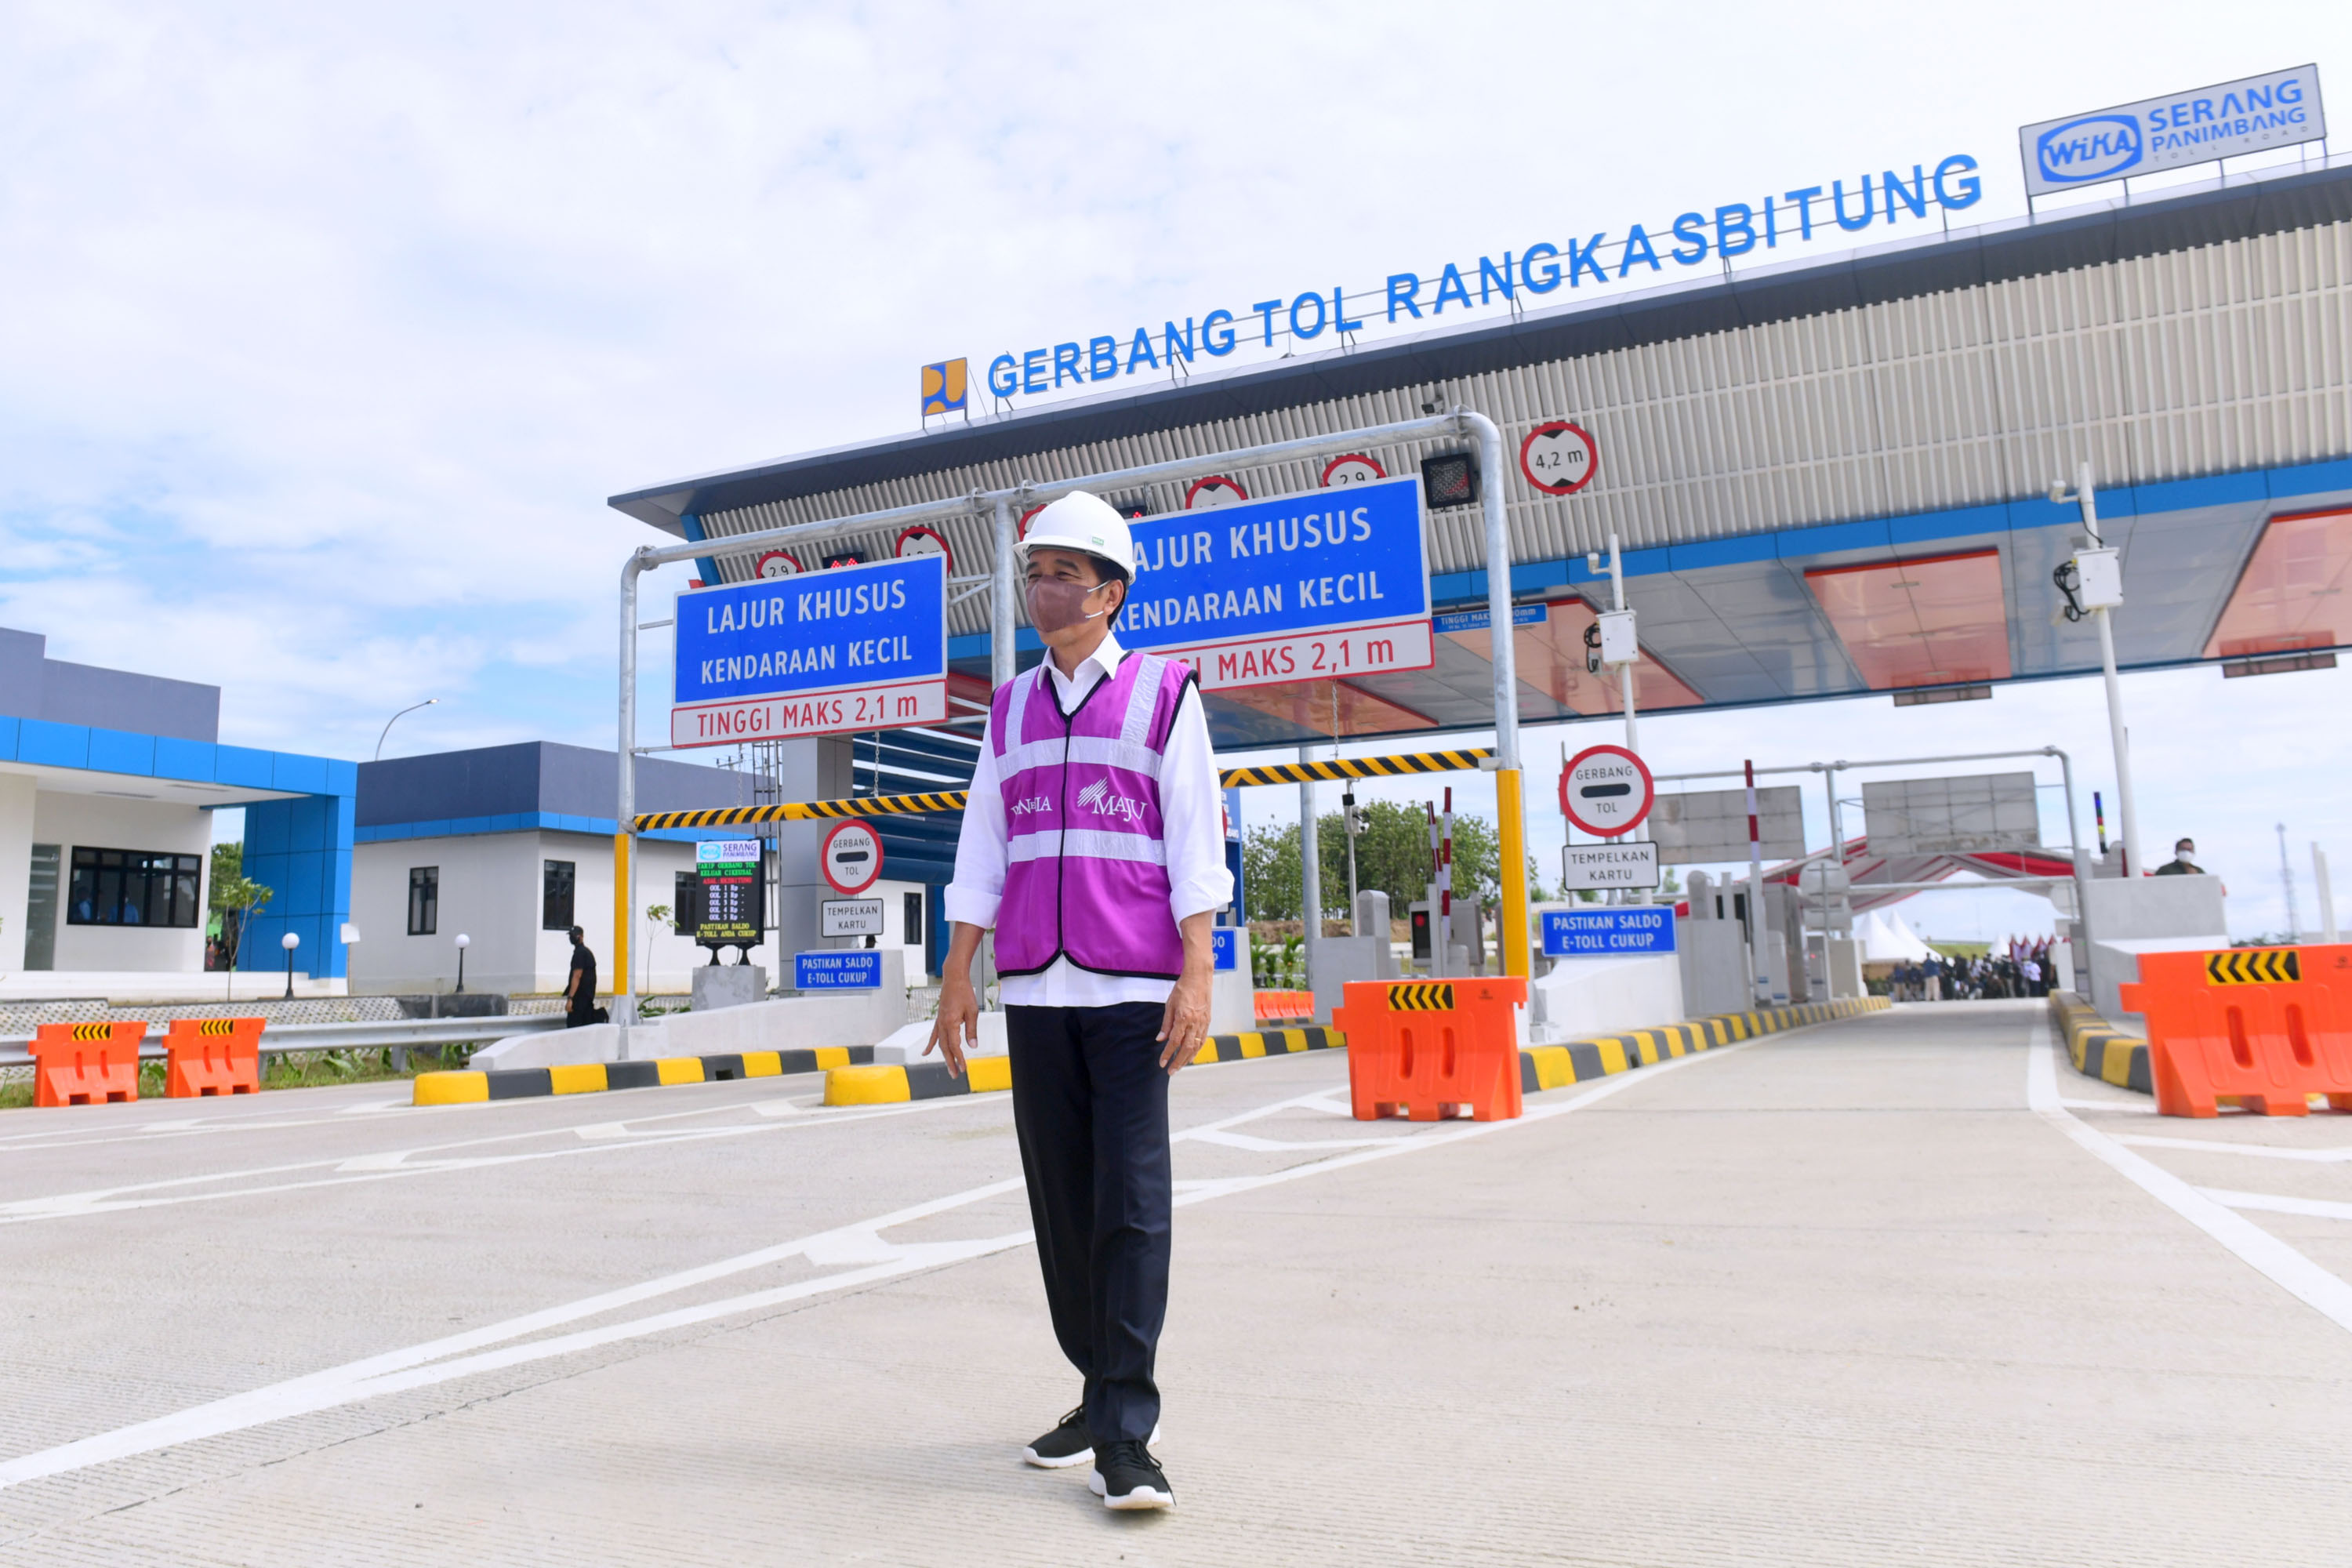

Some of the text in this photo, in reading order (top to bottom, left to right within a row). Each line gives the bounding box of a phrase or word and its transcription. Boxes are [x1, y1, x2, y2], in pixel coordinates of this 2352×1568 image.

[2148, 79, 2303, 132] SERANG
[2151, 107, 2307, 153] PANIMBANG
[2154, 125, 2309, 162] TOLL ROAD
[988, 154, 1983, 398] GERBANG TOL RANGKASBITUNG
[1535, 449, 1584, 470] 4,2 m
[1132, 506, 1372, 573] AJUR KHUSUS
[1300, 571, 1385, 609] KECIL
[707, 578, 906, 635] LAJUR KHUSUS
[1441, 615, 1468, 625] TINGGI
[701, 635, 913, 685] KENDARAAN KECIL
[1218, 644, 1295, 682] MAKS
[1311, 641, 1350, 673] 2,1
[1367, 638, 1395, 664] m
[697, 695, 917, 738] TINGGI MAKS 2,1 m
[1575, 765, 1634, 780] GERBANG
[1091, 794, 1148, 822] MAJU
[1595, 802, 1618, 815] TOL
[723, 843, 757, 851] SERANG
[833, 837, 871, 848] GERBANG
[1571, 851, 1650, 863] TEMPELKAN
[845, 866, 859, 876] TOL
[1588, 868, 1633, 881] KARTU
[826, 905, 878, 916] TEMPELKAN
[837, 919, 866, 931] KARTU
[1552, 914, 1662, 931] PASTIKAN SALDO
[1562, 934, 1655, 950] E-TOLL CUKUP
[802, 956, 873, 970] PASTIKAN SALDO
[807, 971, 868, 985] E-TOLL CUKUP
